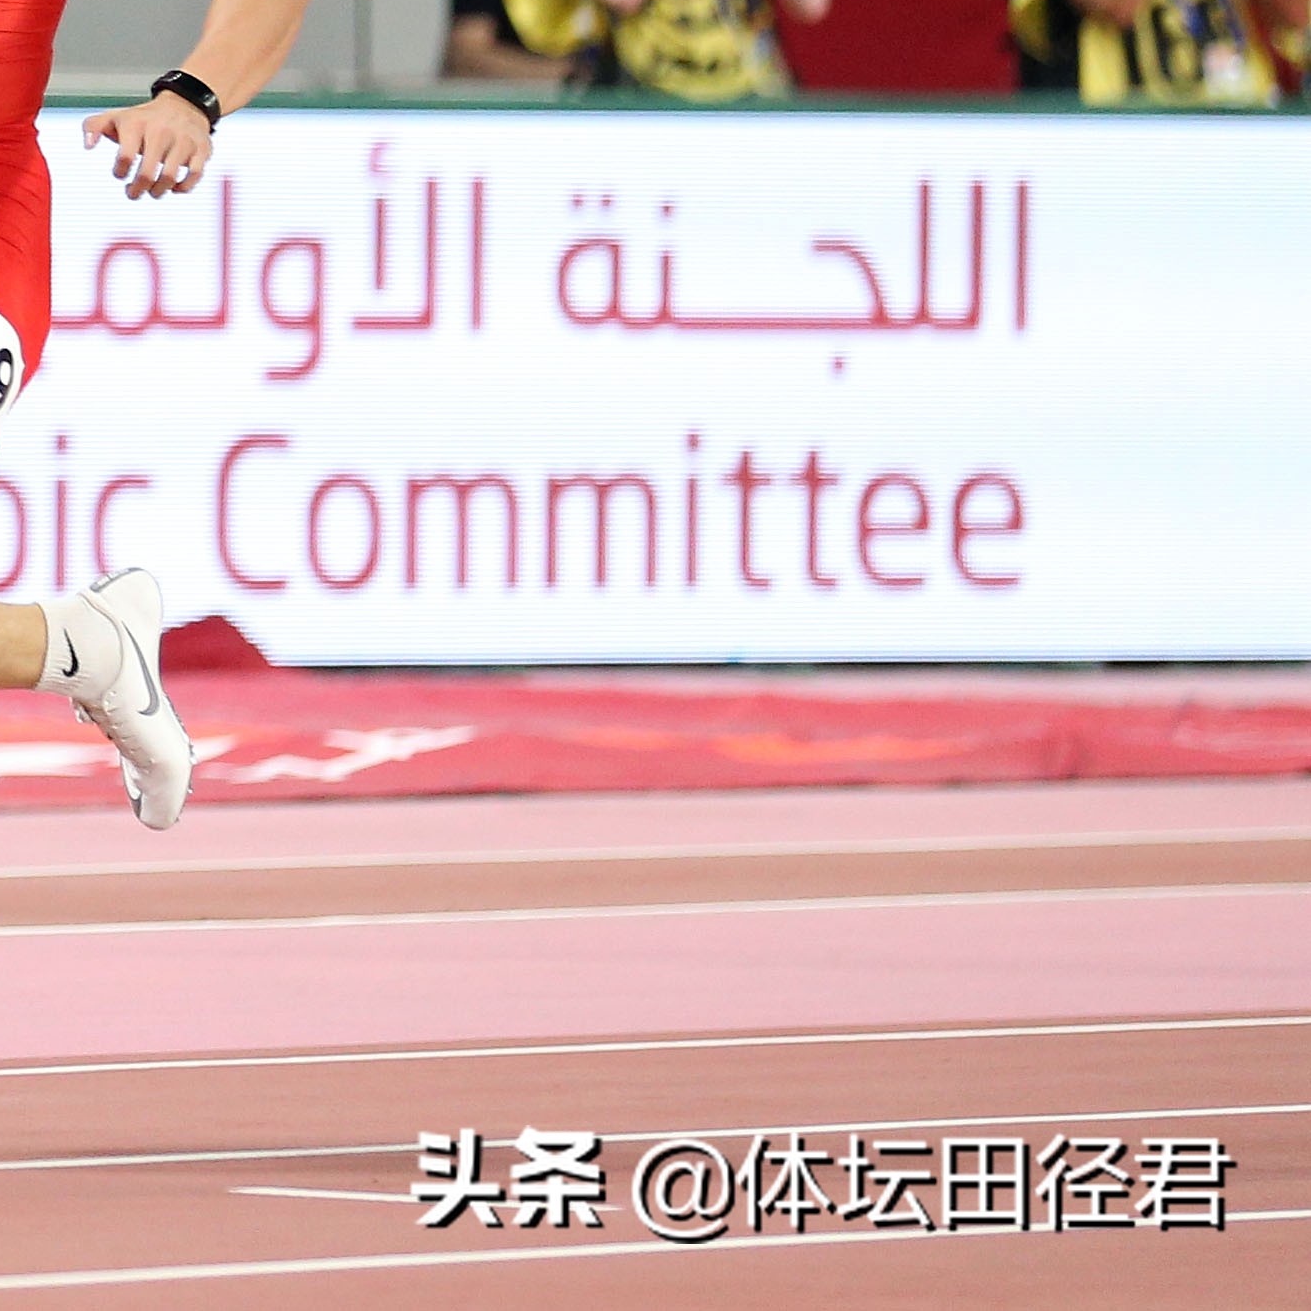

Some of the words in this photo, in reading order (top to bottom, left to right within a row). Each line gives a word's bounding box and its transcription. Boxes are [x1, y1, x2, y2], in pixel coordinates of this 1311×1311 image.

[50, 142, 486, 382] الأولم
[556, 177, 1030, 374] اللجنة
[217, 432, 1026, 593] Committee
